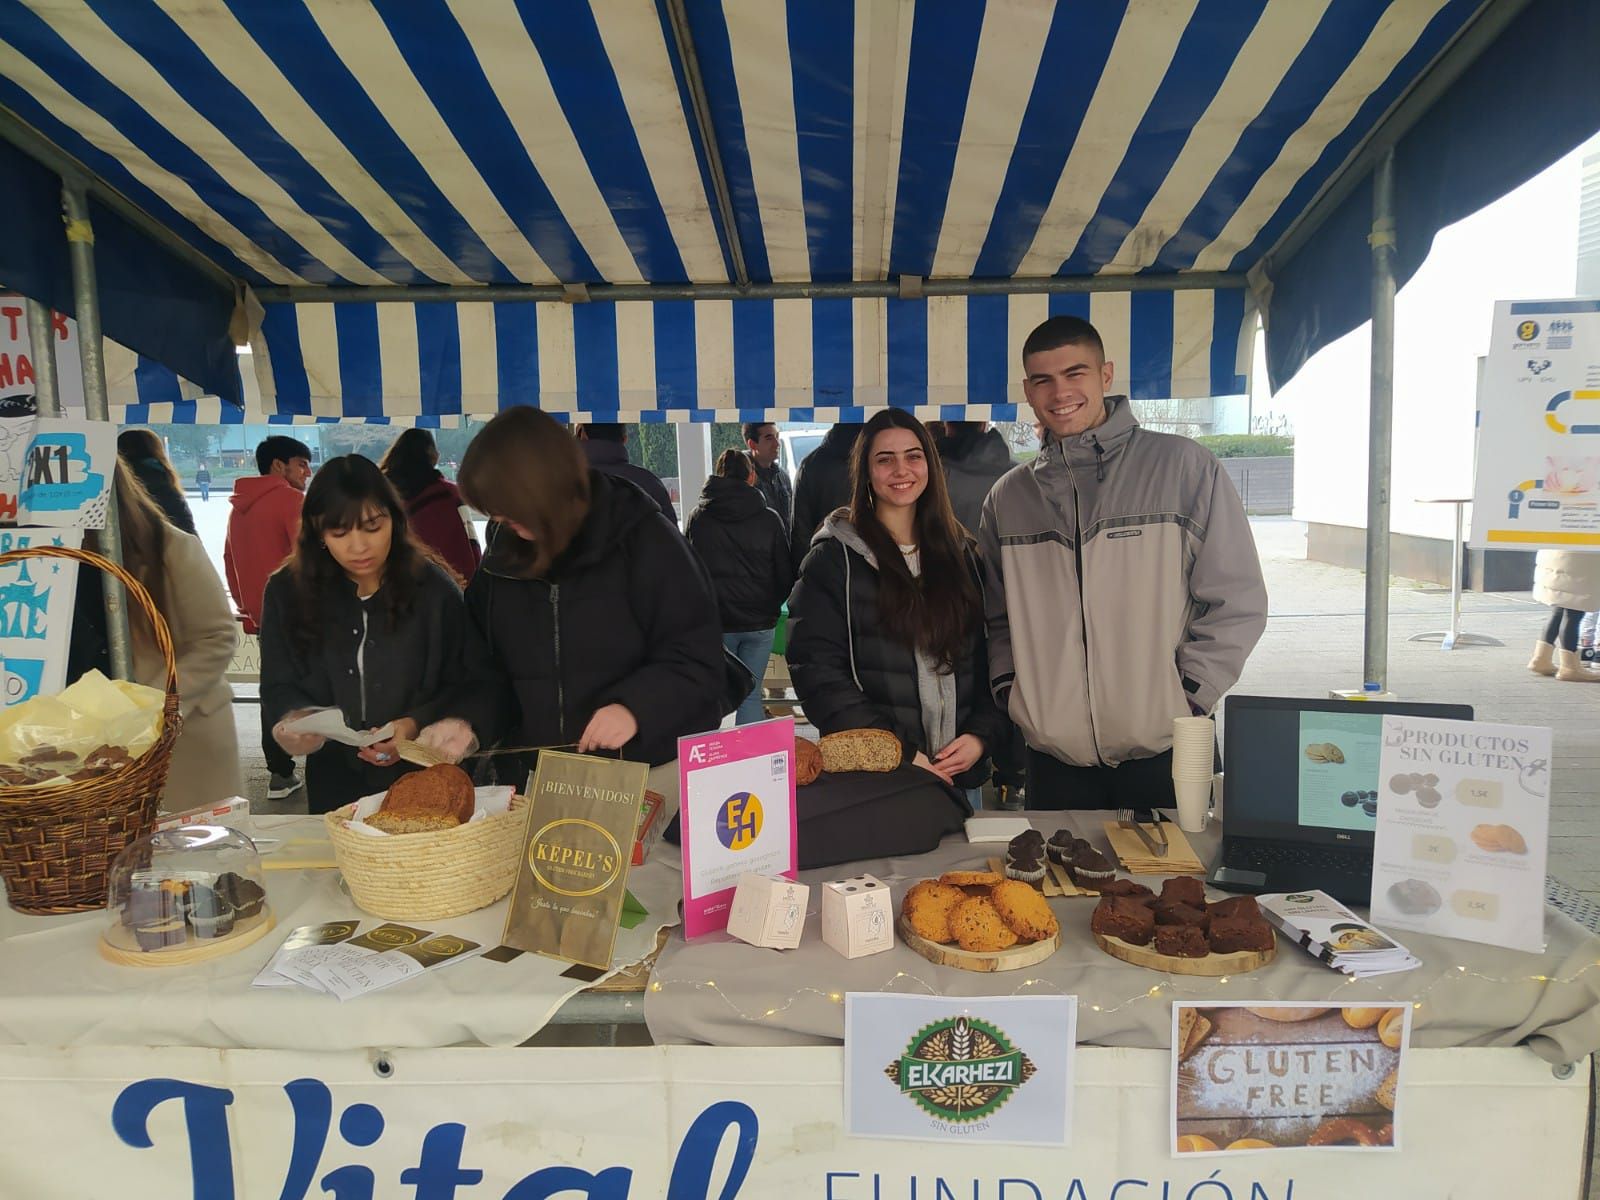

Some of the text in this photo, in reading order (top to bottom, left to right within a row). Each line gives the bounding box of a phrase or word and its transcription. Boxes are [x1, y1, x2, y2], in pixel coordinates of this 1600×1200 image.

[1402, 729, 1529, 753] PRODUCTOS
[1400, 747, 1523, 770] SIN GLUTEN
[541, 780, 634, 805] ¡BIENVENIDOS!
[908, 1061, 1013, 1087] EKARHEZI
[1207, 1049, 1375, 1085] GLUTEN
[1246, 1084, 1334, 1109] FREE
[930, 1119, 991, 1135] SIN GLUTEN
